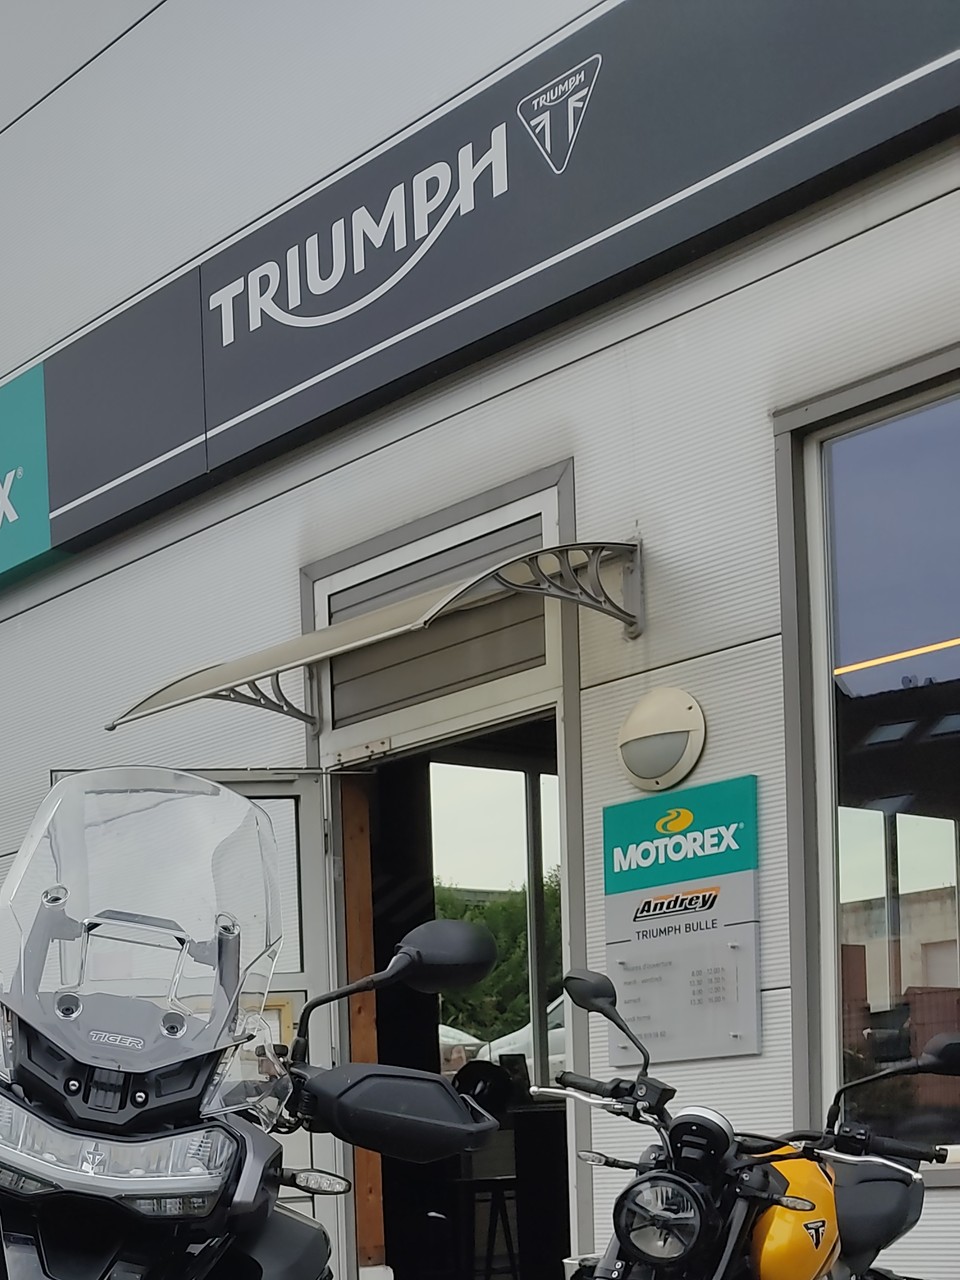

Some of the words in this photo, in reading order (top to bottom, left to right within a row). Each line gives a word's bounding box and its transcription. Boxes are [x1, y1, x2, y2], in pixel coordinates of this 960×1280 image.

[532, 70, 585, 110] TRIUMPH
[209, 122, 508, 347] TRIUMPH
[613, 822, 740, 872] MOTOREX
[638, 892, 716, 915] Andrey
[635, 924, 681, 940] TRIUMPH
[684, 919, 718, 933] BULLE
[89, 1030, 144, 1049] TIGER
